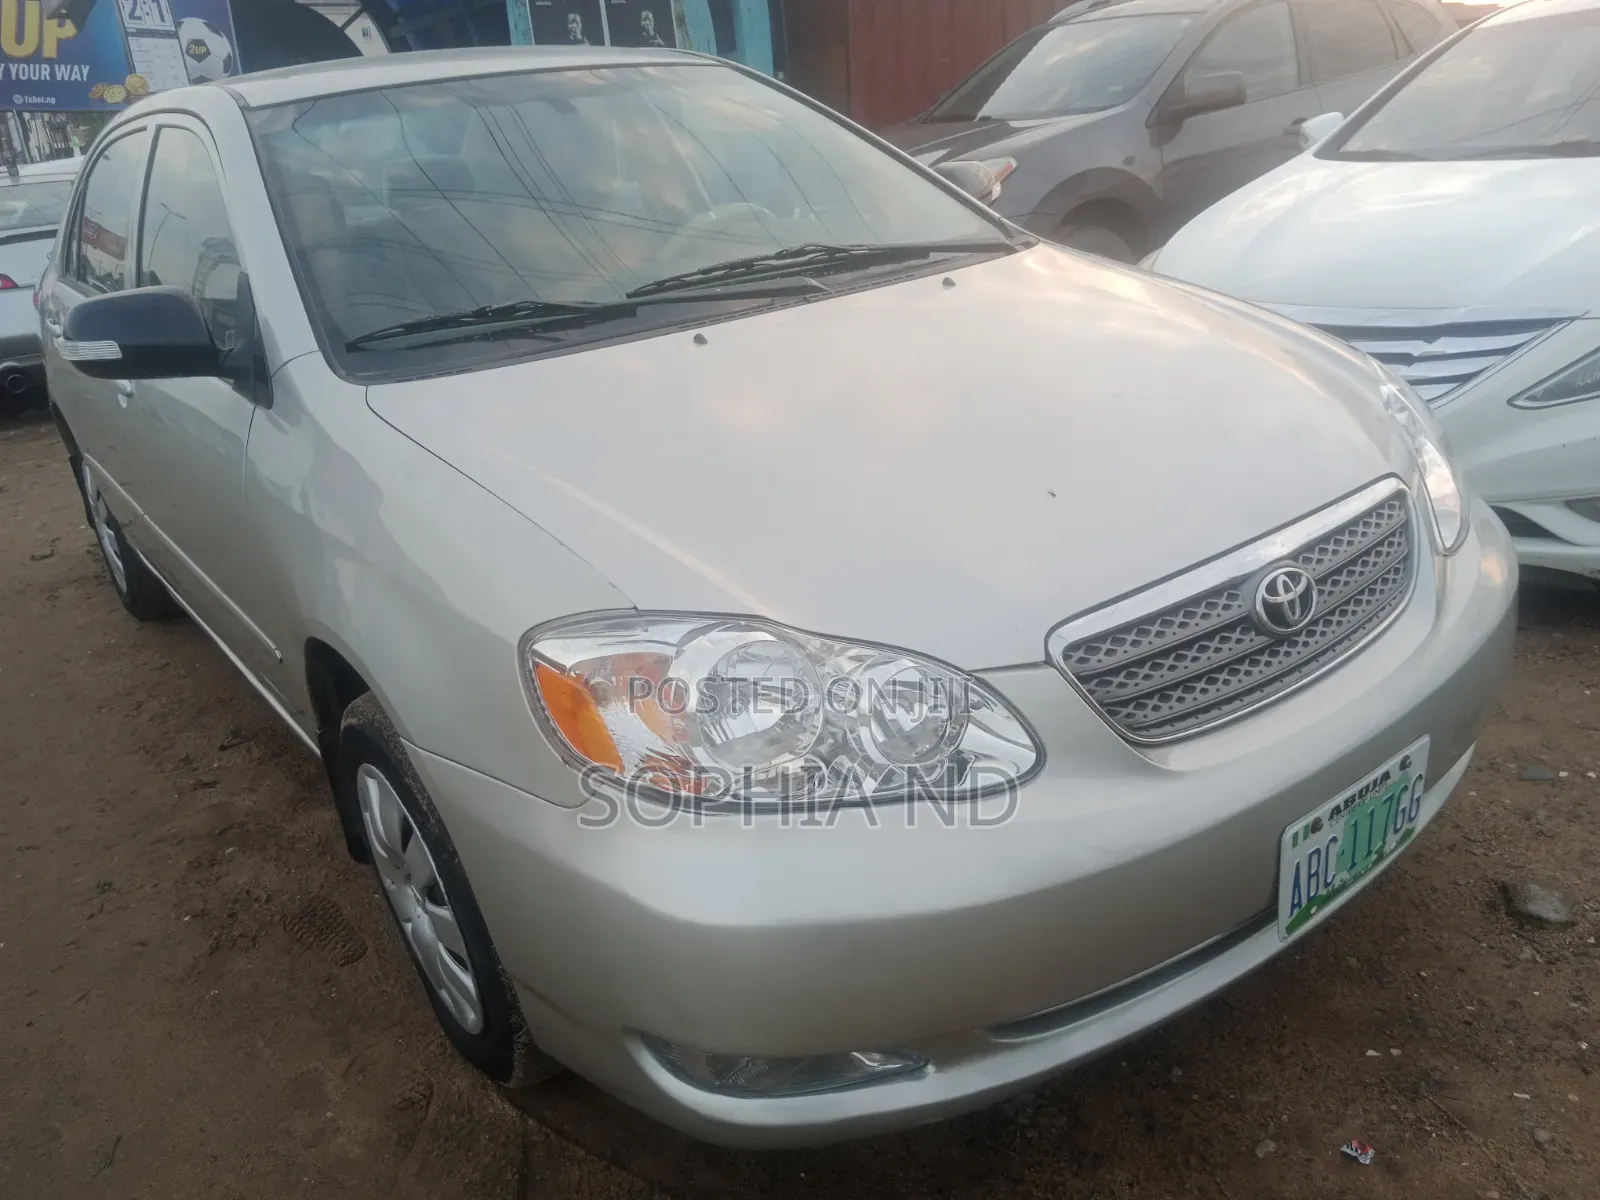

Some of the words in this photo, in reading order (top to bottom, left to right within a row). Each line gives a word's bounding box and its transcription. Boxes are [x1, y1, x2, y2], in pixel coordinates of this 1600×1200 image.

[189, 44, 207, 55] 2UP
[9, 63, 50, 80] YOUR
[54, 64, 90, 81] WAY
[24, 95, 56, 104] 1xbet.ng
[1327, 770, 1391, 821] ABUJA
